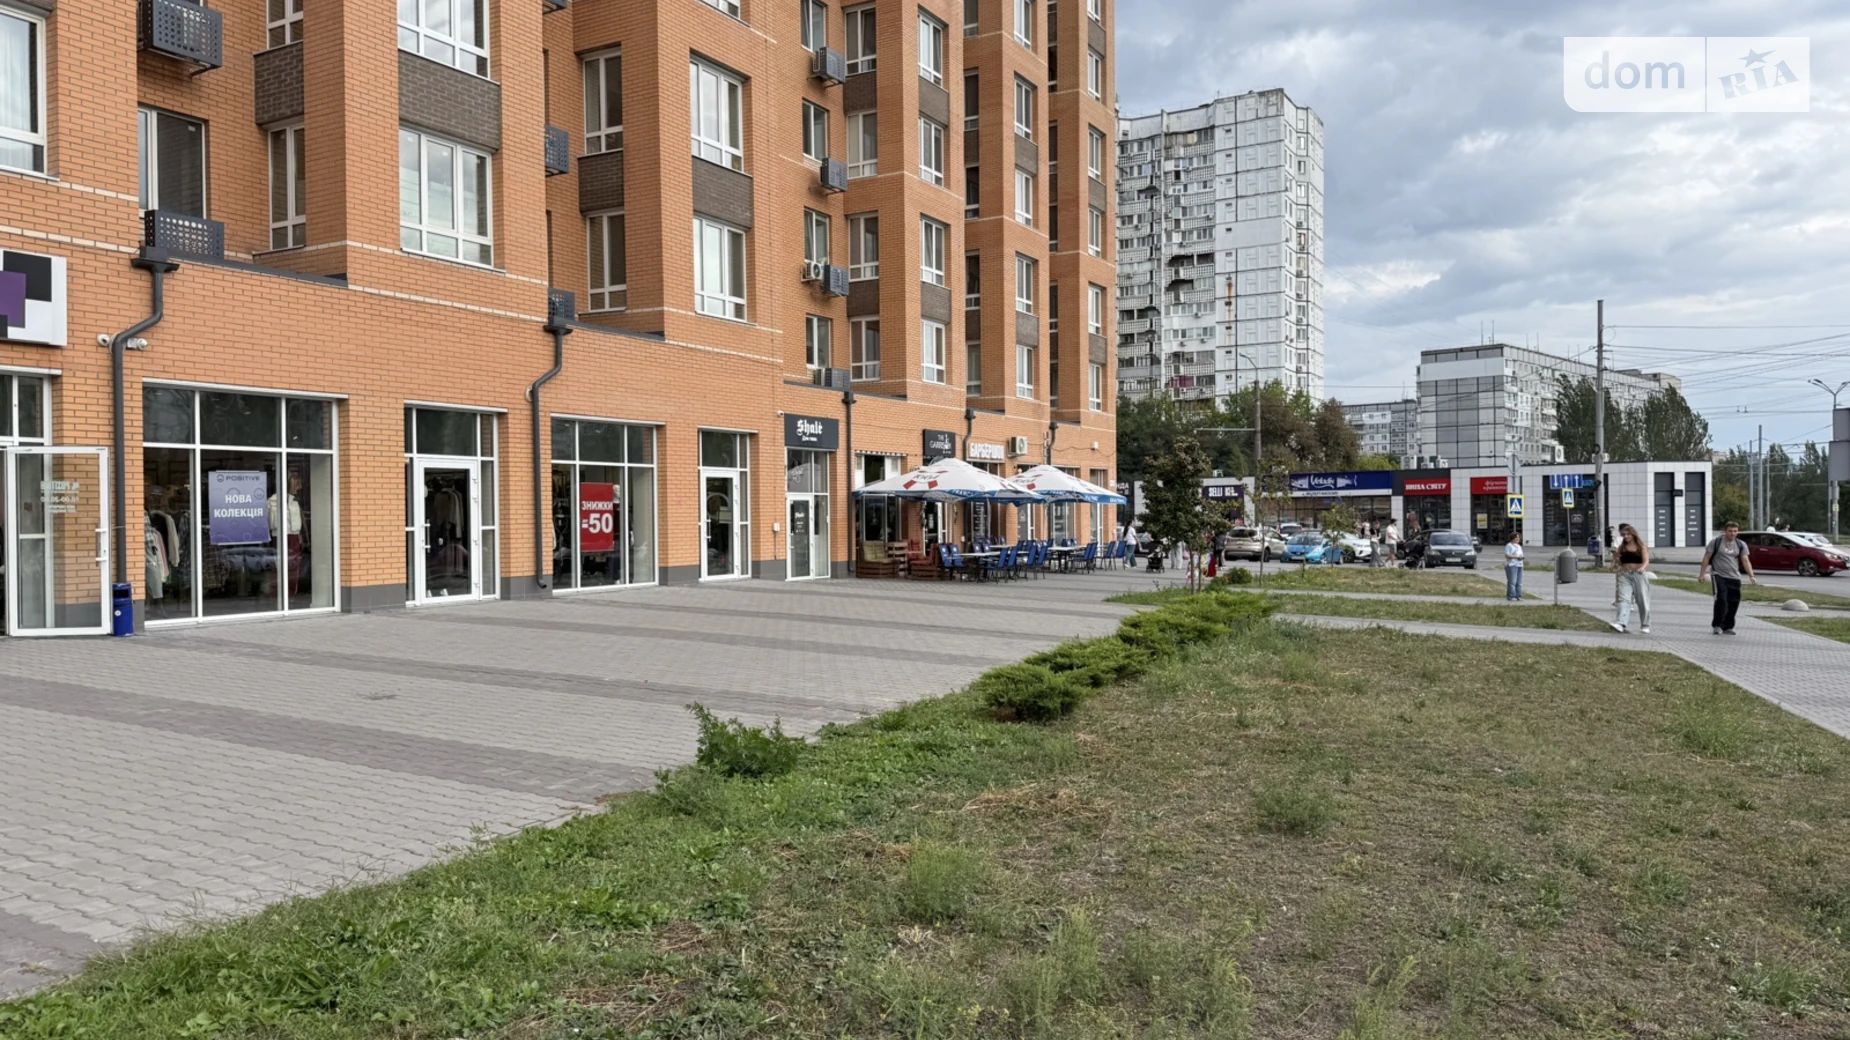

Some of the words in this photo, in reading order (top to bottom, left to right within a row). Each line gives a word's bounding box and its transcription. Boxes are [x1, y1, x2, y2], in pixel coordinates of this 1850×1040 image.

[225, 494, 252, 504] НОВА
[581, 501, 614, 510] ЗНИЖКИ
[214, 507, 264, 519] КОЛЕКЦІЯ
